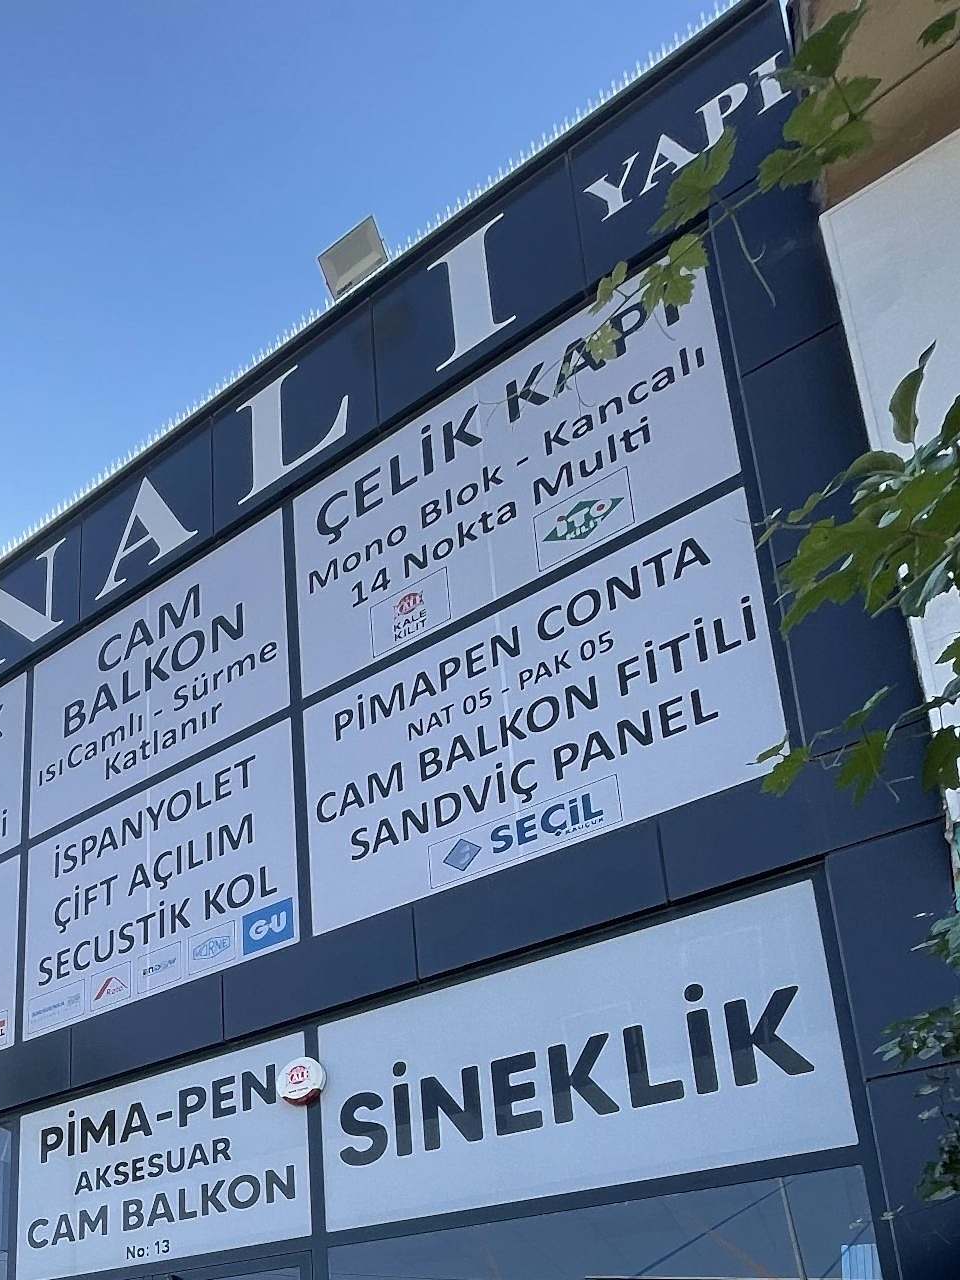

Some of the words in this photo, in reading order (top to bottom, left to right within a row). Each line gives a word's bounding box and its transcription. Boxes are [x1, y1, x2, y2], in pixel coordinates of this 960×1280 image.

[583, 50, 792, 222] YAPI
[309, 525, 407, 594] Mono
[420, 465, 504, 529] Blok
[544, 346, 705, 456] Kancalı
[316, 404, 482, 543] ÇELİK
[351, 567, 392, 608] 14
[403, 500, 518, 579] Nokta
[533, 417, 651, 505] Multi
[63, 602, 245, 738] BALKON
[97, 584, 201, 673] CAM
[173, 639, 278, 713] Sürme
[334, 626, 521, 742] PİMAPEN
[536, 536, 711, 641] CONTA
[393, 608, 427, 632] KALE
[105, 702, 223, 781] Katlanır
[316, 762, 404, 824] CAM
[418, 676, 600, 782] BALKON
[618, 596, 757, 697] FİTİLİ
[406, 703, 454, 741] NAT
[463, 688, 493, 715] 05
[518, 654, 573, 691] PAK
[579, 631, 615, 661] 05
[53, 754, 257, 879] İSPANYOLET
[350, 759, 538, 861] SANDVİÇ
[553, 689, 719, 780] PANEL
[38, 894, 191, 987] SECUSTİK
[204, 865, 278, 921] KOL
[53, 873, 119, 934] ÇİFT
[128, 813, 253, 891] AÇILIM
[40, 1064, 277, 1164] PİMA-PEN
[337, 982, 816, 1167] SİNEKLİK
[27, 1205, 108, 1249] CAM
[122, 1165, 296, 1232] BALKON
[74, 1137, 231, 1195] AKSESUAR
[126, 1244, 150, 1260] No:
[155, 1239, 170, 1255] 13
